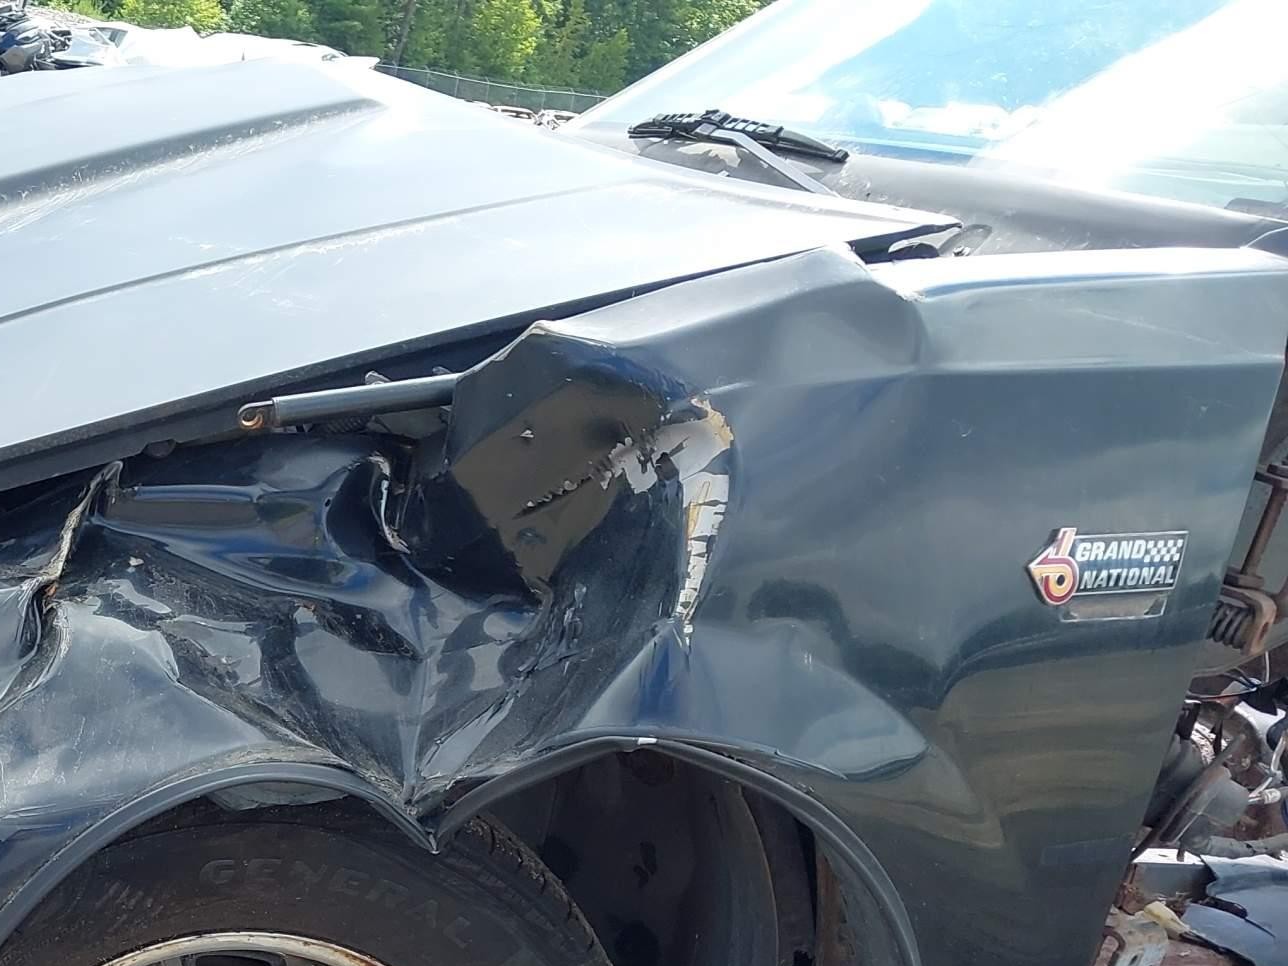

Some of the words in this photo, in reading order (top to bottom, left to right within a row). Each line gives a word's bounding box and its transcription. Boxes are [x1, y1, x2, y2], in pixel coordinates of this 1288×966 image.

[1075, 539, 1146, 562] GRAND
[1079, 565, 1175, 589] NATIONAL
[199, 858, 473, 948] GENERAL
